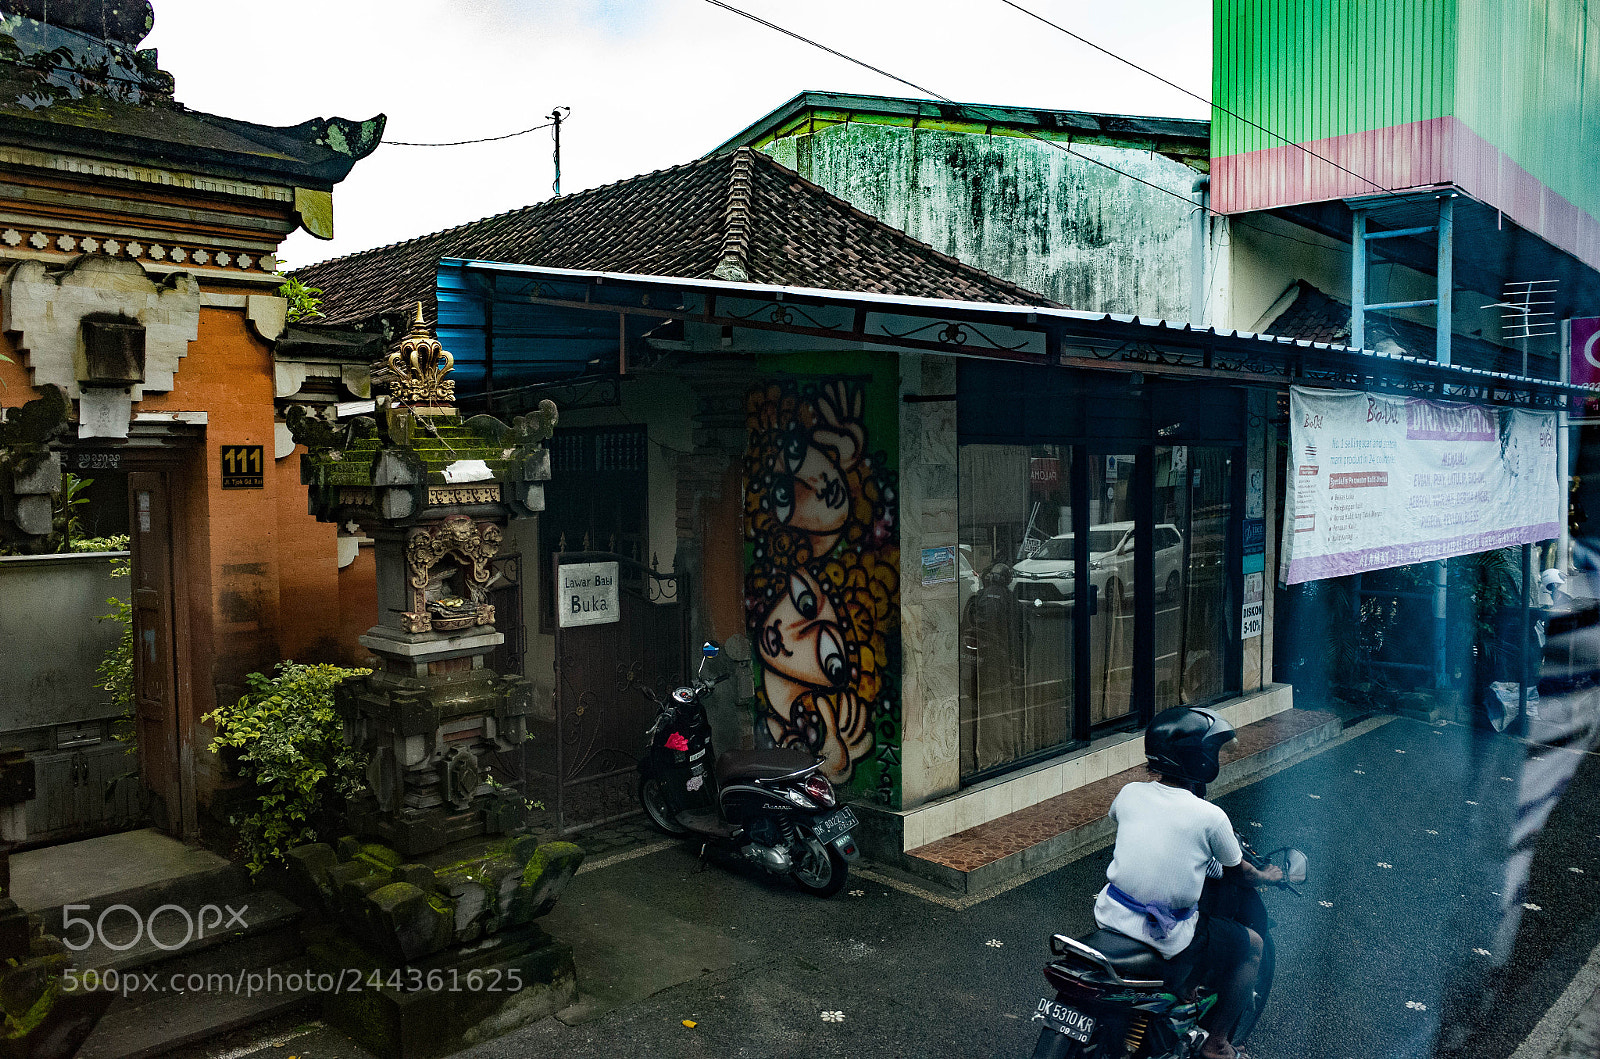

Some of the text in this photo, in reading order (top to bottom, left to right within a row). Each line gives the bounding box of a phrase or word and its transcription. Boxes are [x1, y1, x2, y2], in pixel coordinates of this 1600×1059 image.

[224, 448, 260, 473] 111
[565, 577, 591, 588] Lawar
[571, 595, 608, 613] Buka
[1243, 605, 1263, 619] DISKON
[1243, 619, 1261, 634] 5-10%
[814, 824, 825, 836] DK
[1038, 998, 1094, 1033] DK 5310 KR
